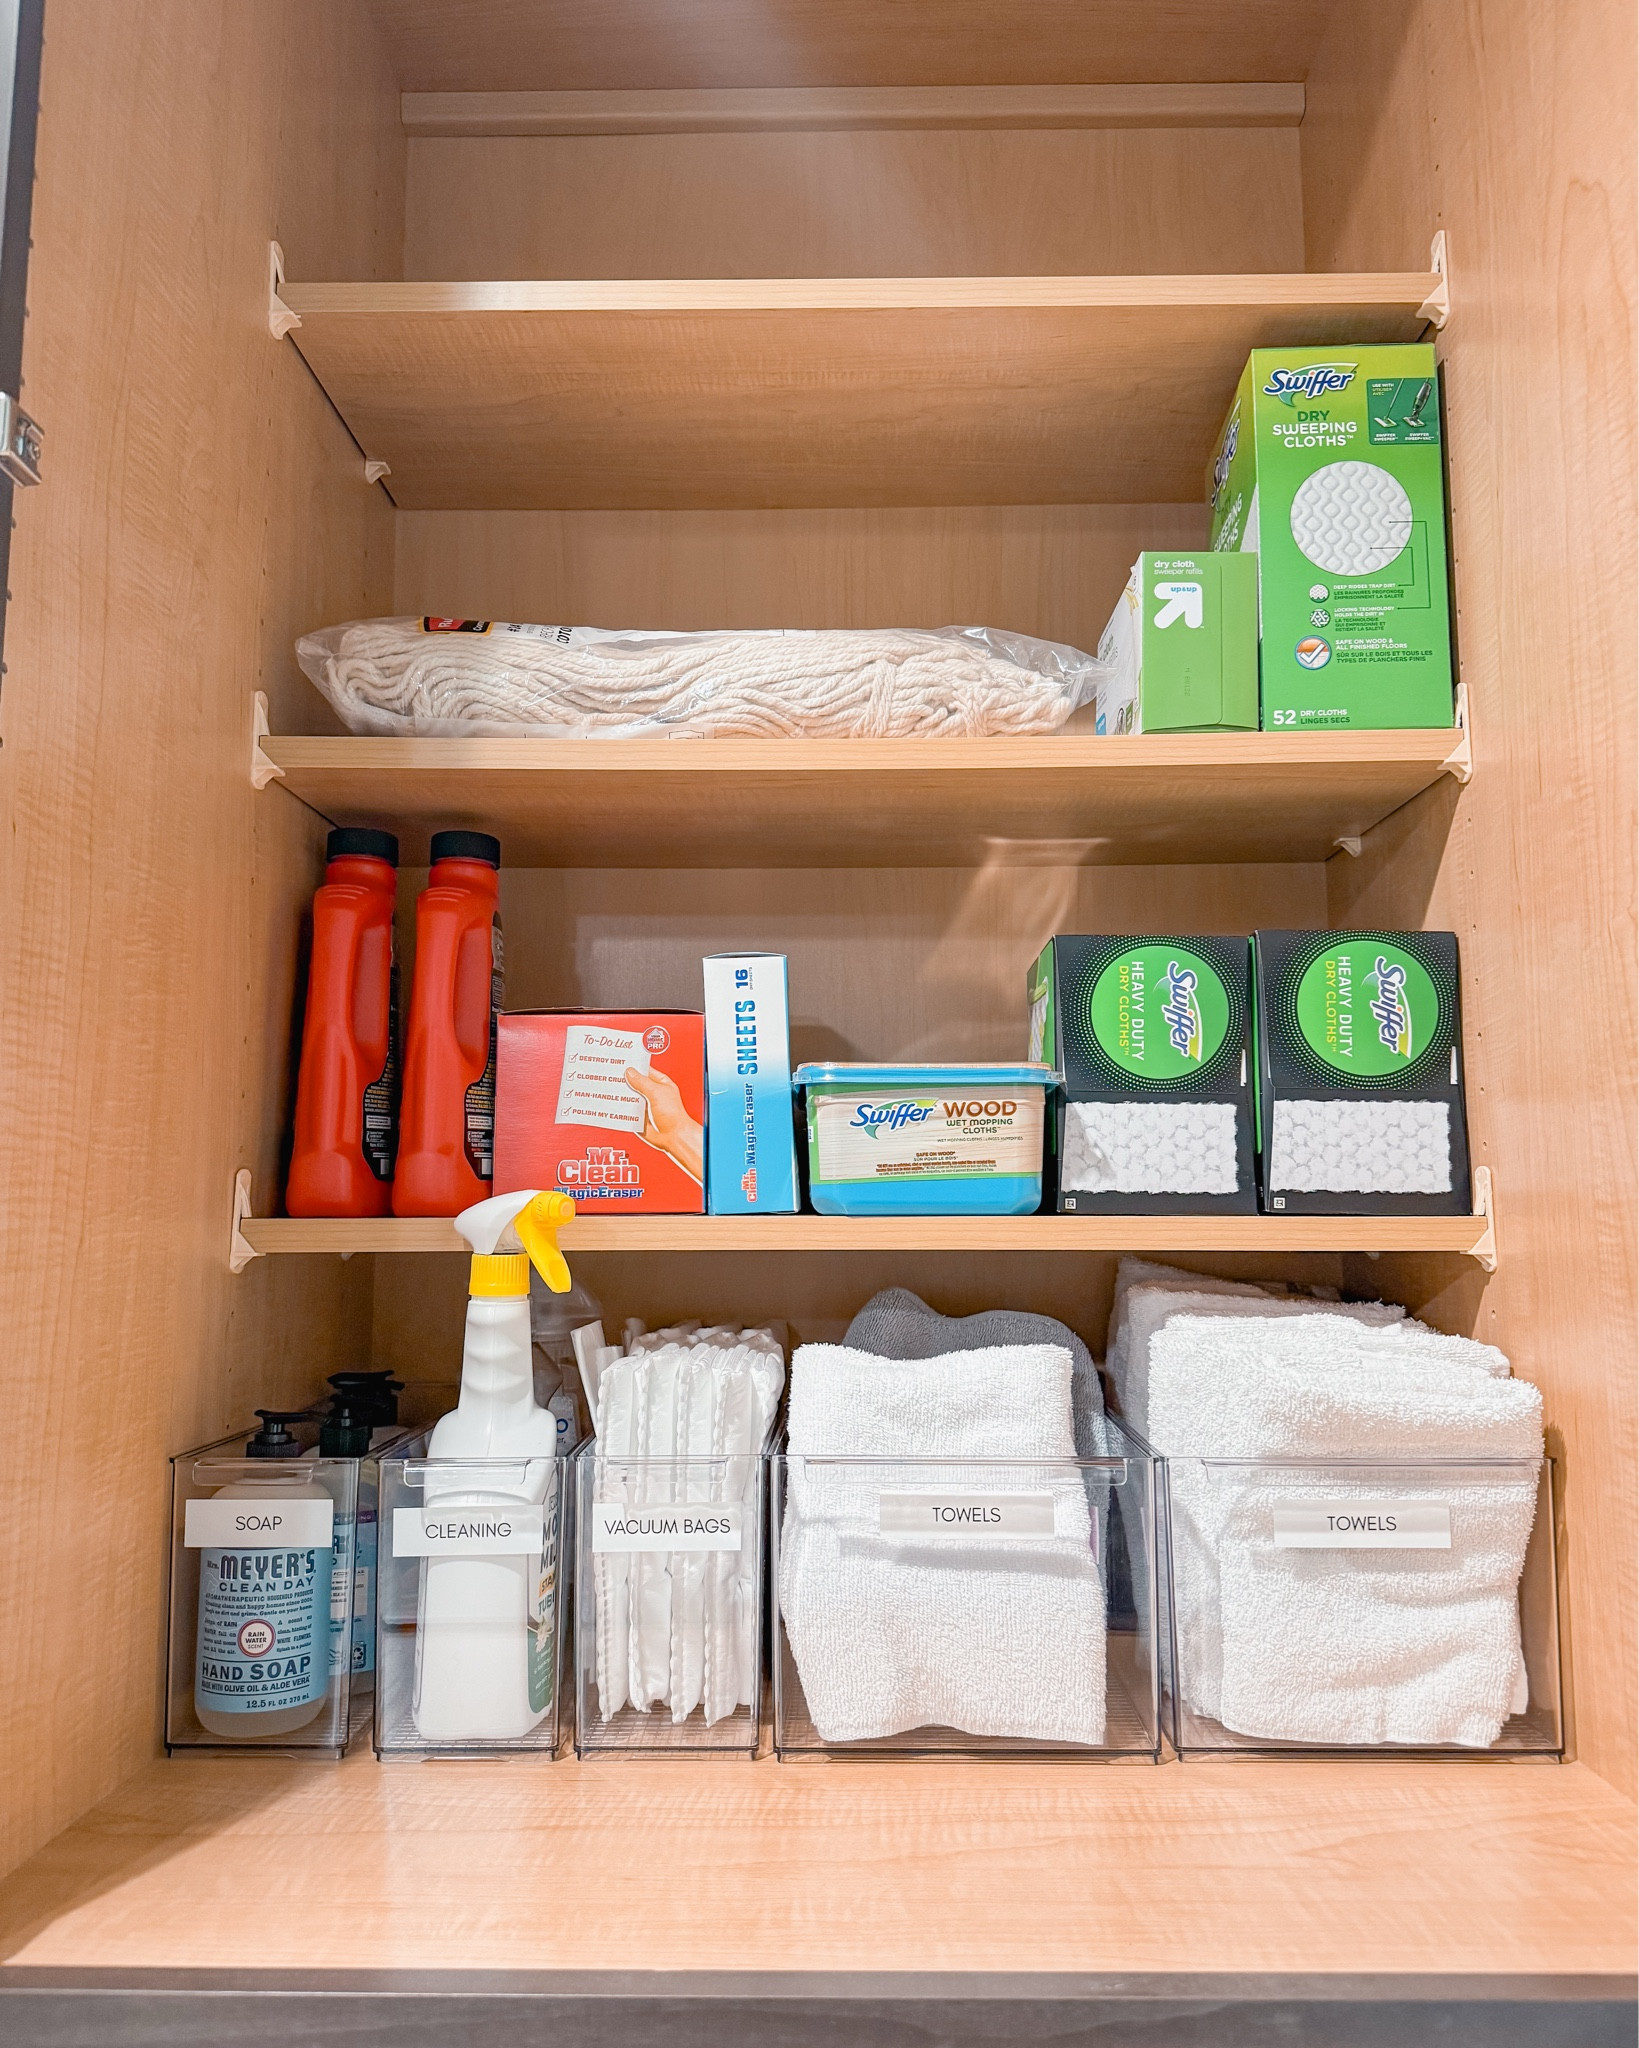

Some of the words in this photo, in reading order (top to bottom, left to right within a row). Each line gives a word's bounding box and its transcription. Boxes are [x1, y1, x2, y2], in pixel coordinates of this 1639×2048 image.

[1264, 369, 1353, 399] Swiffer
[1297, 410, 1330, 422] DRY
[1272, 421, 1358, 436] SWEEPING
[1154, 560, 1169, 568] dry
[1172, 560, 1194, 568] cloth
[1273, 710, 1296, 725] 52
[735, 969, 748, 988] 16
[1119, 966, 1128, 992] DRY
[1325, 961, 1335, 986] DRY
[1338, 956, 1351, 1008] HEAVY
[1131, 961, 1145, 1013] HEAVY
[1162, 961, 1197, 1057] Swiffer
[1370, 956, 1407, 1054] Swiffer
[584, 1034, 613, 1047] To-Do
[615, 1038, 633, 1049] List
[735, 1000, 758, 1075] SHEETS
[1132, 1019, 1145, 1061] DUTY
[1339, 1015, 1353, 1057] DUTY
[579, 1055, 608, 1063] DESTROY
[575, 1092, 619, 1101] MAN-HANDLE
[572, 1109, 596, 1117] POLISH
[850, 1103, 935, 1130] Swiffer
[943, 1101, 1017, 1118] WOOD
[743, 1082, 757, 1166] MagicEraser
[970, 1118, 1013, 1126] MOPPING
[587, 1147, 629, 1166] Mr.
[558, 1160, 639, 1184] Clean
[742, 1173, 750, 1190] Mr.
[747, 1168, 757, 1202] Clean
[235, 1516, 282, 1530] SOAP
[932, 1507, 1002, 1523] TOWELS
[425, 1522, 512, 1539] CLEANING
[605, 1520, 678, 1535] VACUUM
[683, 1519, 731, 1534] BAGS
[1327, 1516, 1398, 1532] TOWELS
[220, 1550, 315, 1580] MEYER'S
[220, 1582, 276, 1592] CLEAN
[284, 1576, 314, 1590] DAY
[202, 1661, 243, 1680] HAND
[250, 1656, 311, 1680] SOAP
[211, 1682, 223, 1691] WITH
[224, 1684, 245, 1692] OLIVE
[247, 1684, 259, 1692] OIL
[270, 1680, 290, 1691] ALOE
[246, 1699, 266, 1708] 12.5
